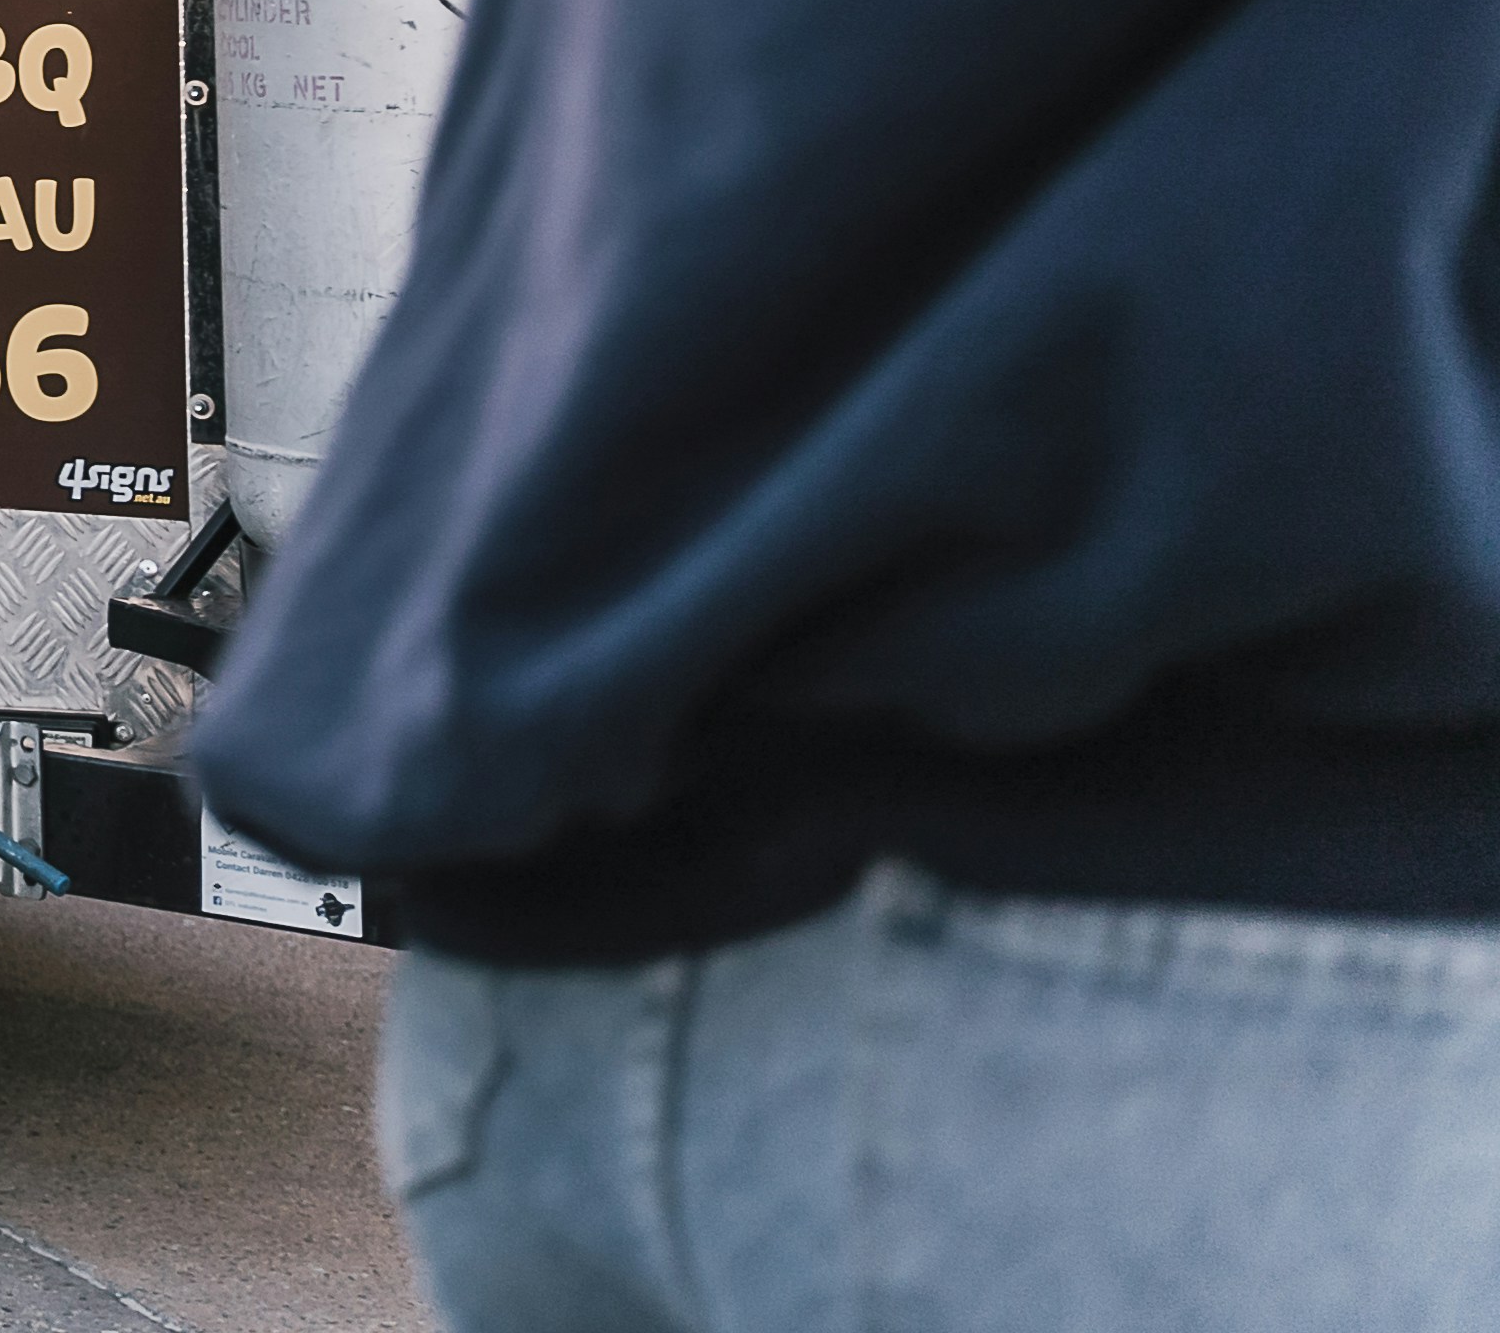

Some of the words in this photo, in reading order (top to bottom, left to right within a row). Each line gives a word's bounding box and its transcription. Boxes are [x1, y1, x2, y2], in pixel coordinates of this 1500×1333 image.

[241, 72, 267, 98] KG
[294, 75, 345, 101] NET
[58, 458, 174, 503] 4signs
